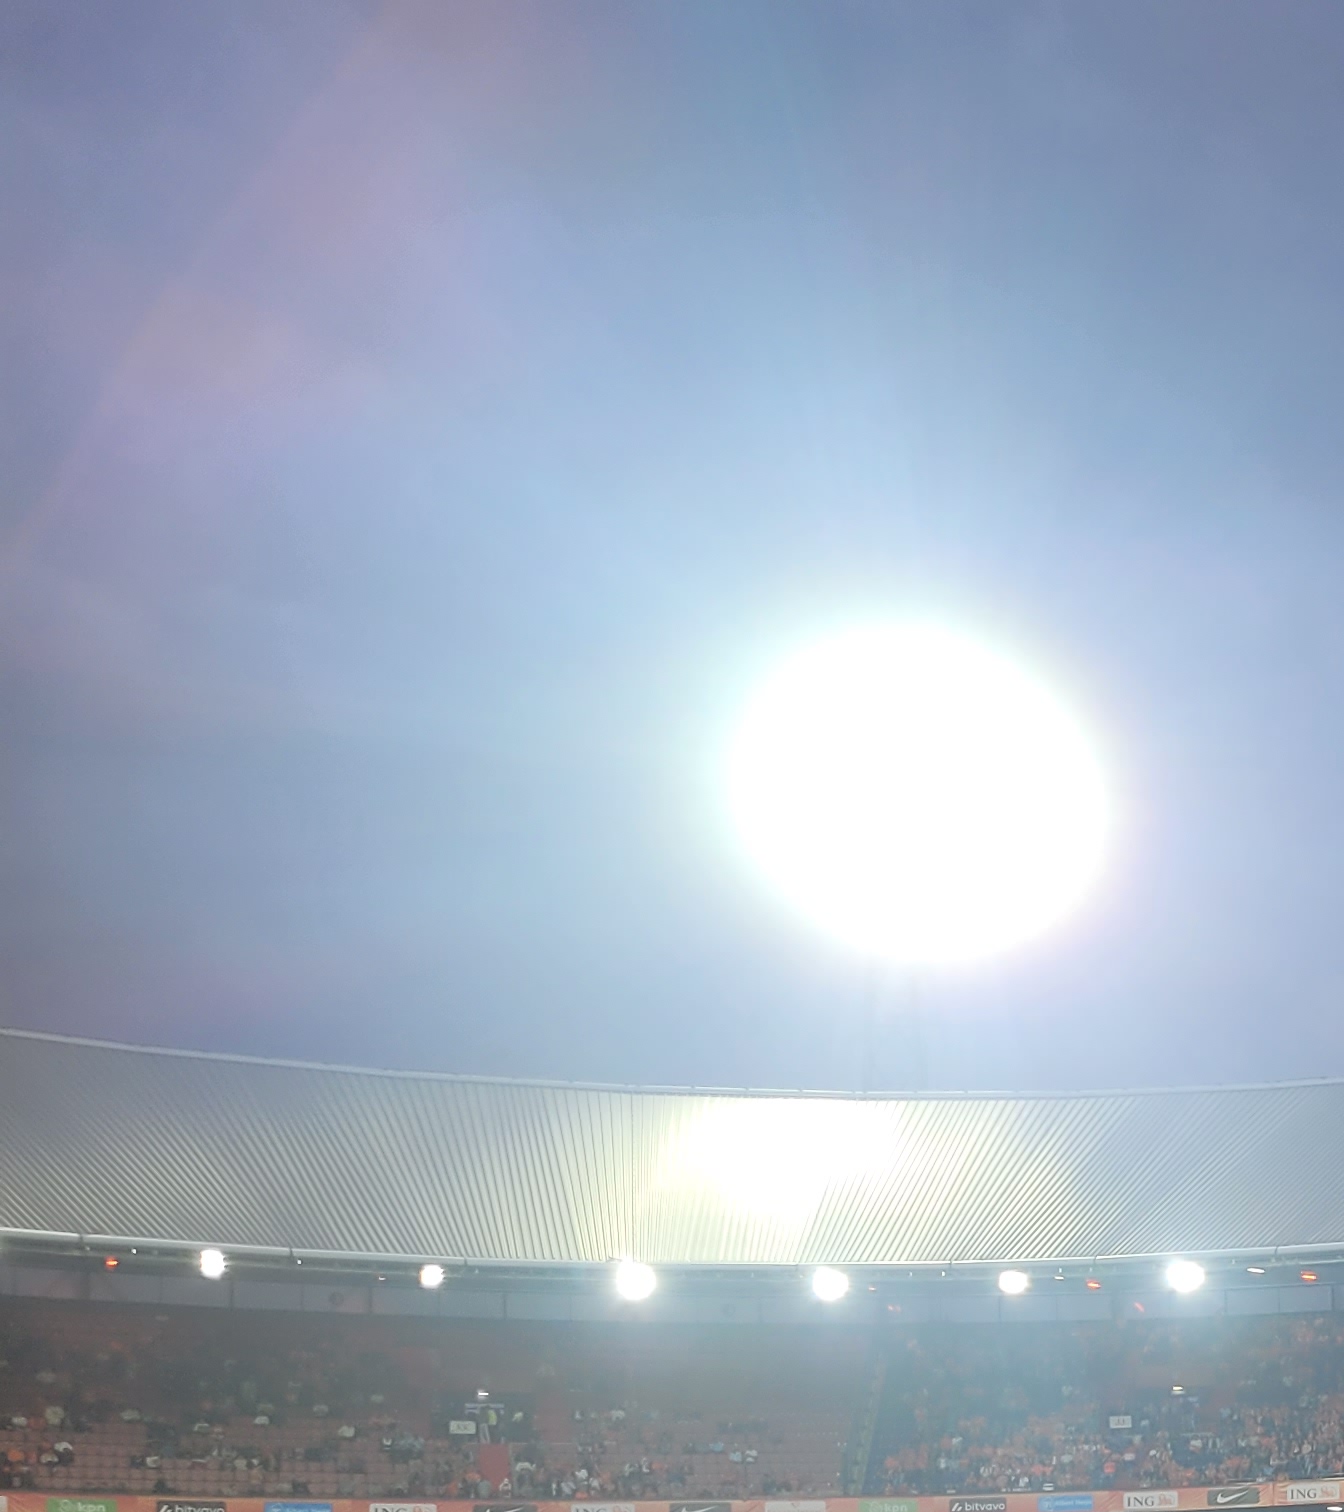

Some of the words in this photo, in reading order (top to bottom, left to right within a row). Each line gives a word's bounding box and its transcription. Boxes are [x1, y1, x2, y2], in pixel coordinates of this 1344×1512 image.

[1290, 1488, 1317, 1500] ING
[964, 1501, 1006, 1512] bitvavo
[1127, 1495, 1155, 1507] ING
